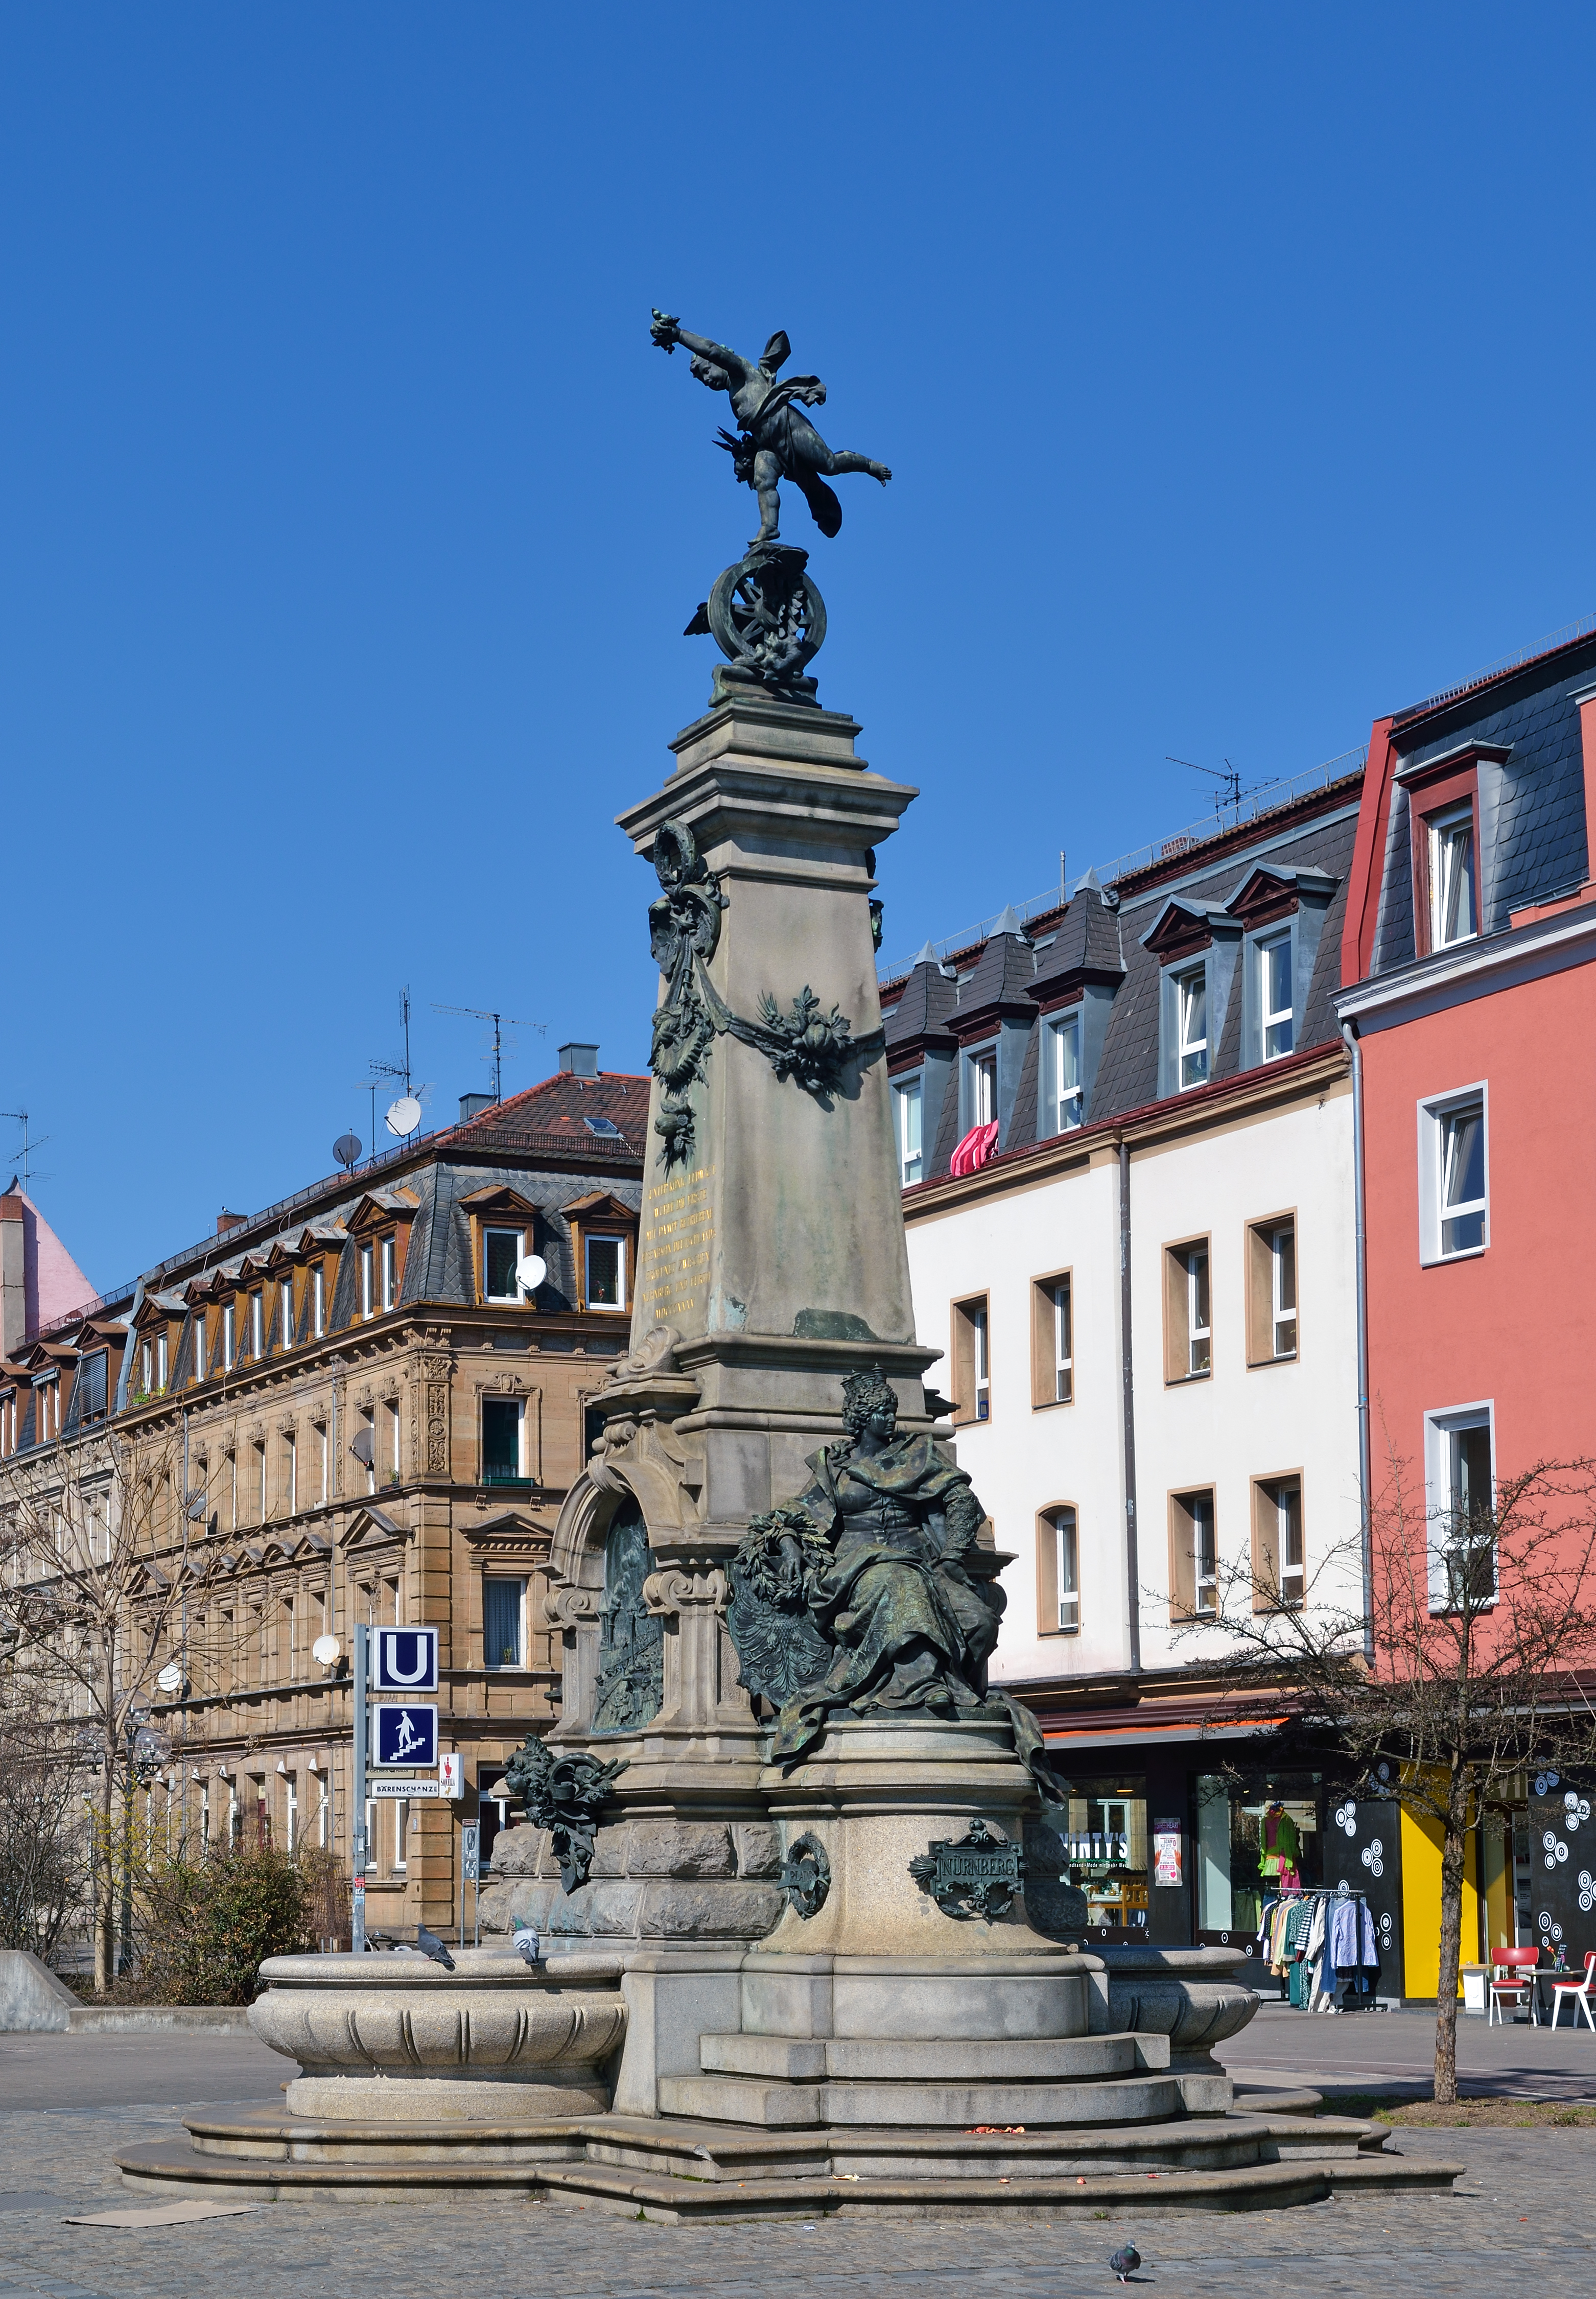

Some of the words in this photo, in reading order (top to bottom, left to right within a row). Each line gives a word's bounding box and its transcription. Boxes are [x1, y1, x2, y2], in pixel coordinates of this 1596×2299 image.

[676, 1197, 686, 1210] DIE
[646, 1228, 656, 1240] MIT
[658, 1219, 678, 1237] DAMPF
[678, 1250, 709, 1271] ZWISCHEN
[675, 1279, 688, 1292] UND
[387, 1635, 427, 1684] U
[440, 1778, 455, 1788] SAQUELLA
[1059, 1832, 1128, 1859] VINTY'S
[941, 1854, 1015, 1876] NÜRNBERG
